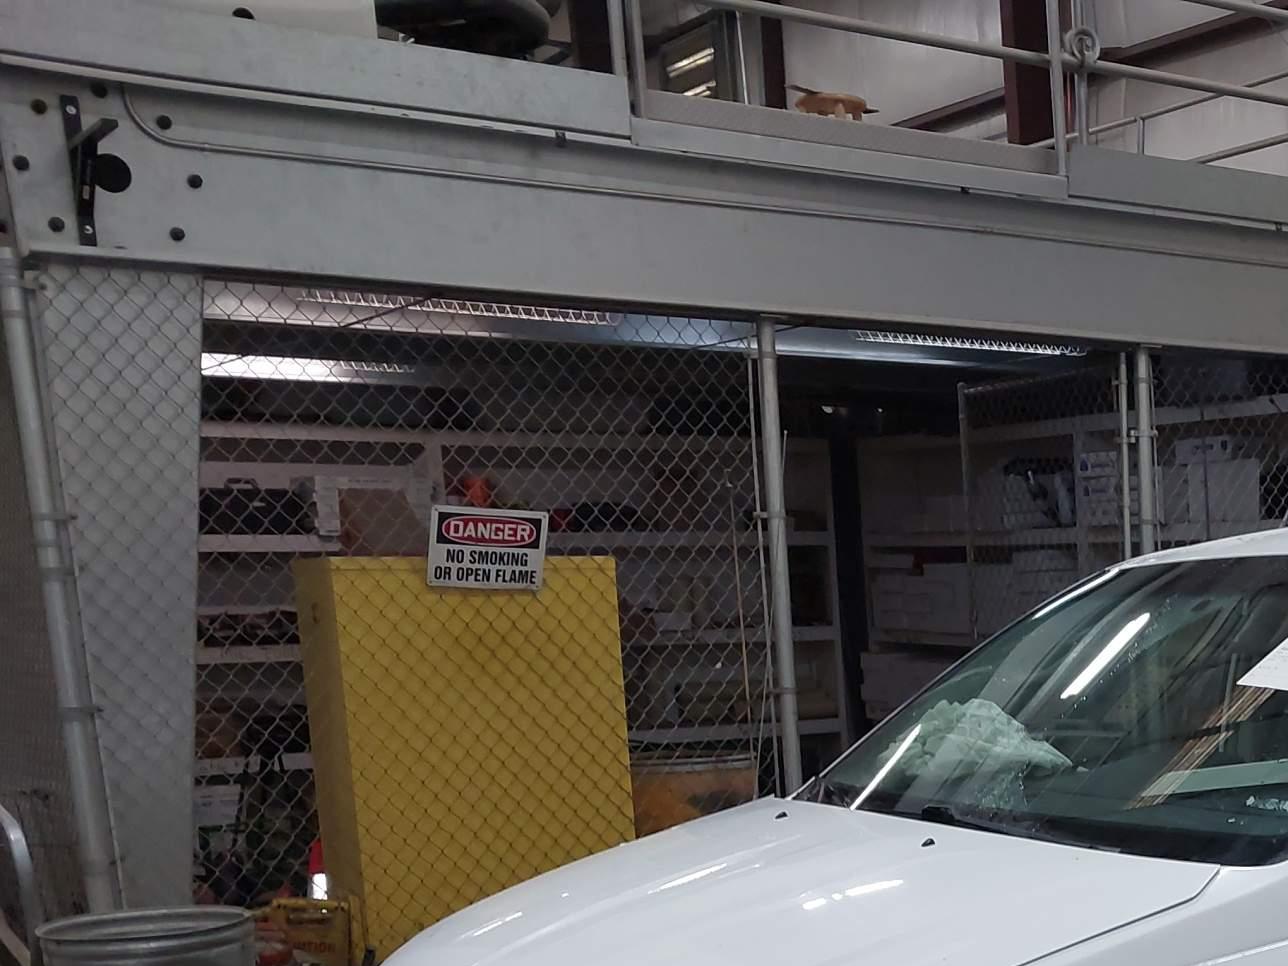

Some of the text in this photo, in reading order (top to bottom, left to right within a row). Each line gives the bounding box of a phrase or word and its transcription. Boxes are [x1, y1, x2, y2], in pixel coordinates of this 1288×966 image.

[449, 520, 531, 541] DANGER
[446, 548, 529, 567] NO SMOKING
[434, 566, 537, 585] OR OPEN FLAME
